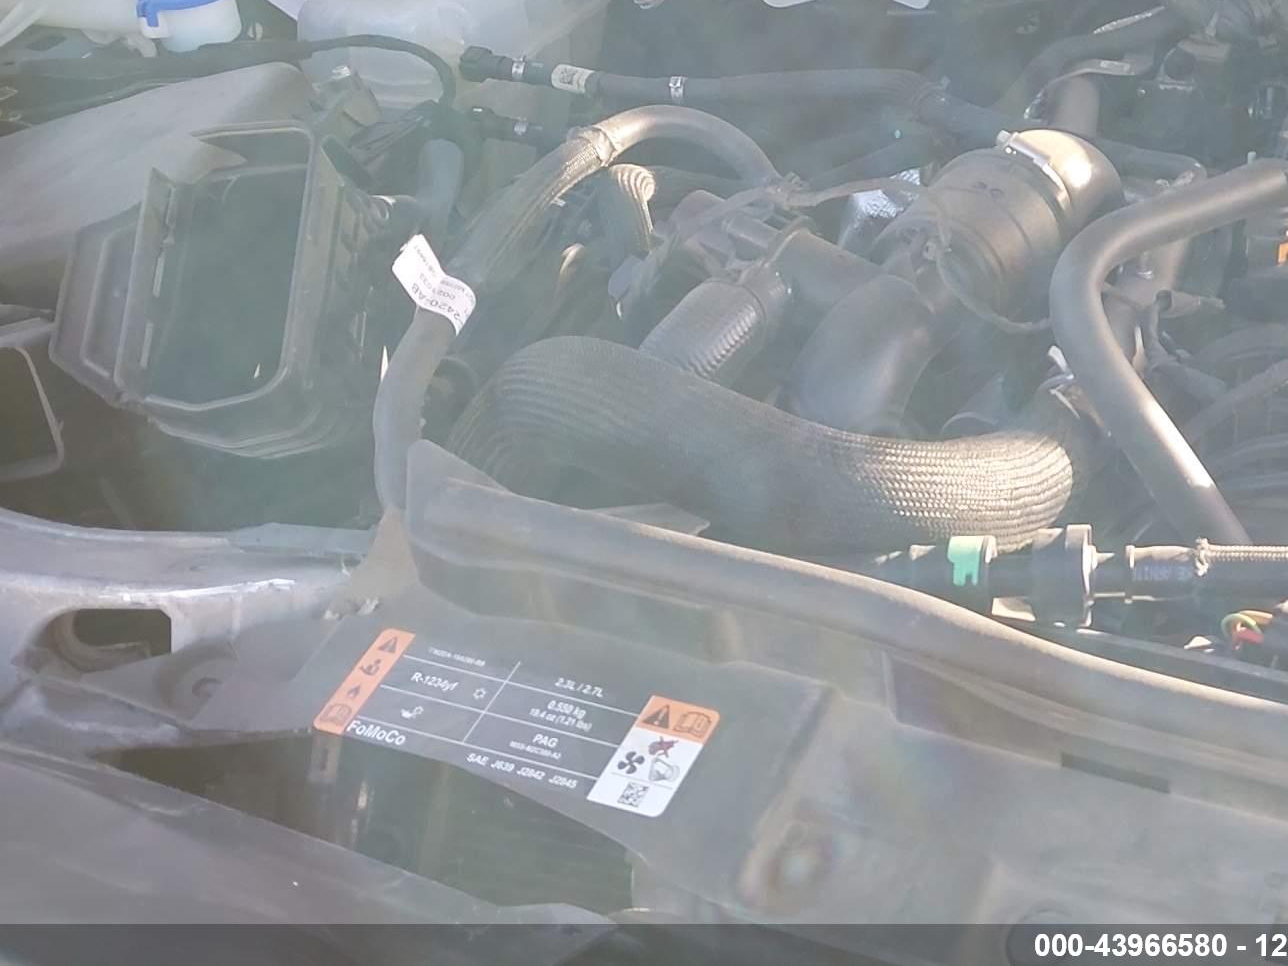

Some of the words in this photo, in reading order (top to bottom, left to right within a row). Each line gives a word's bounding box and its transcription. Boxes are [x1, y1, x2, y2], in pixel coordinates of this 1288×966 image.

[410, 672, 459, 692] R-1234yf
[582, 684, 604, 698] 2.7L
[573, 705, 587, 720] kg
[346, 720, 406, 746] FoMoCo
[532, 734, 558, 749] PAG
[466, 753, 489, 766] SAE
